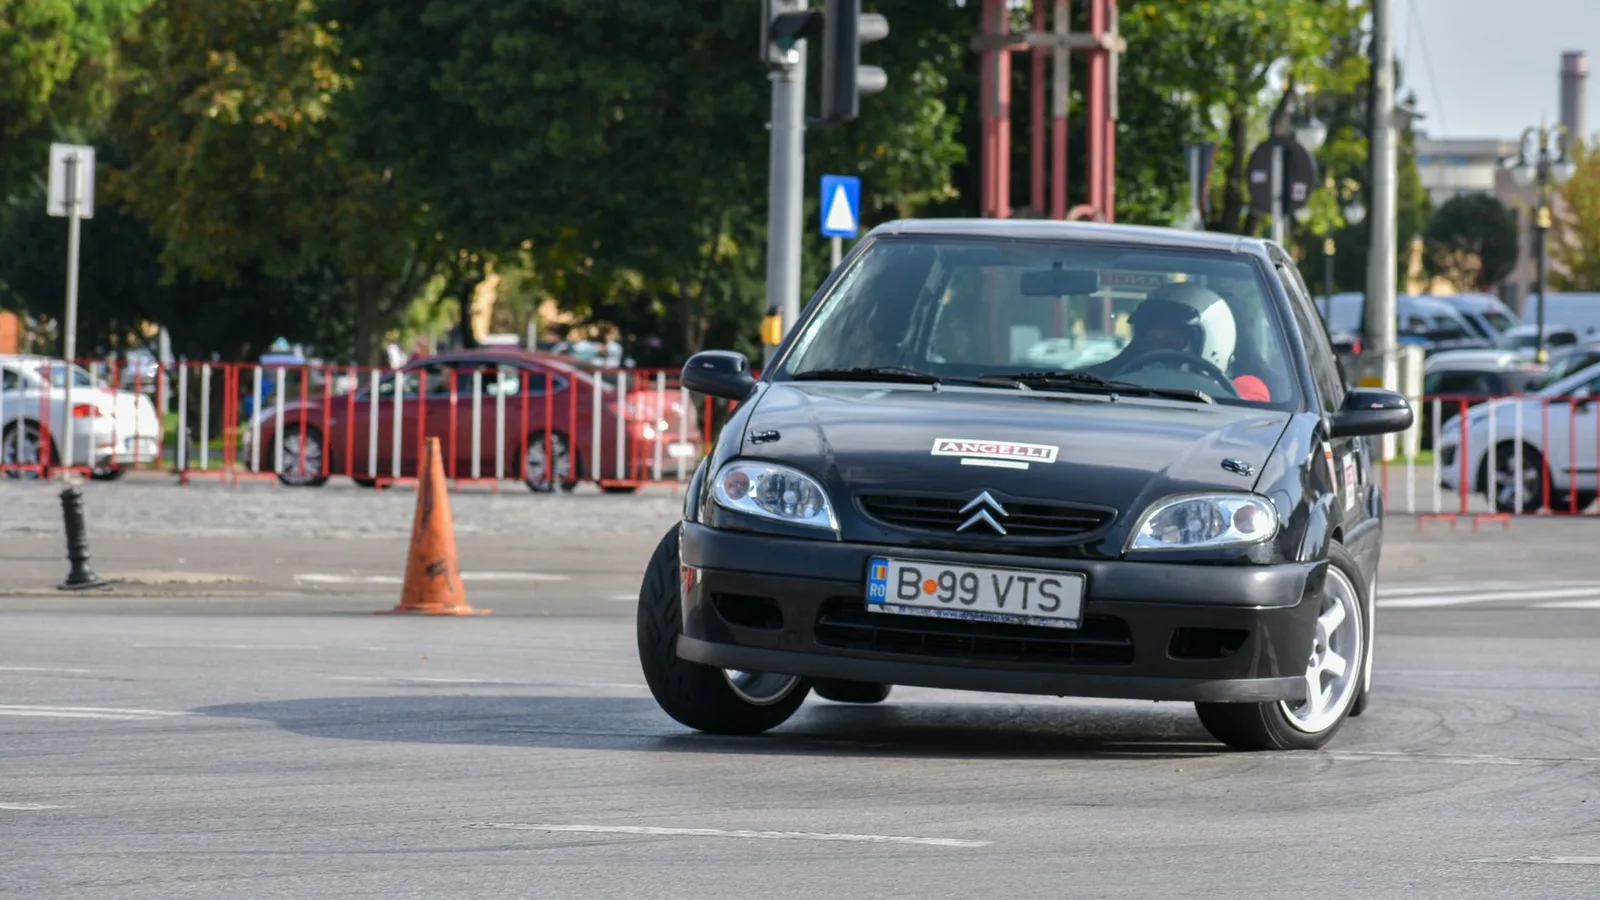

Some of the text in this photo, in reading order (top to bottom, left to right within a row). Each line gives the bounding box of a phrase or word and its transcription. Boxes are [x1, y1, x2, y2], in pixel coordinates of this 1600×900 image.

[941, 442, 1051, 458] ANGELLI
[869, 583, 886, 598] RO
[937, 570, 980, 606] 99
[991, 573, 1063, 613] VTS
